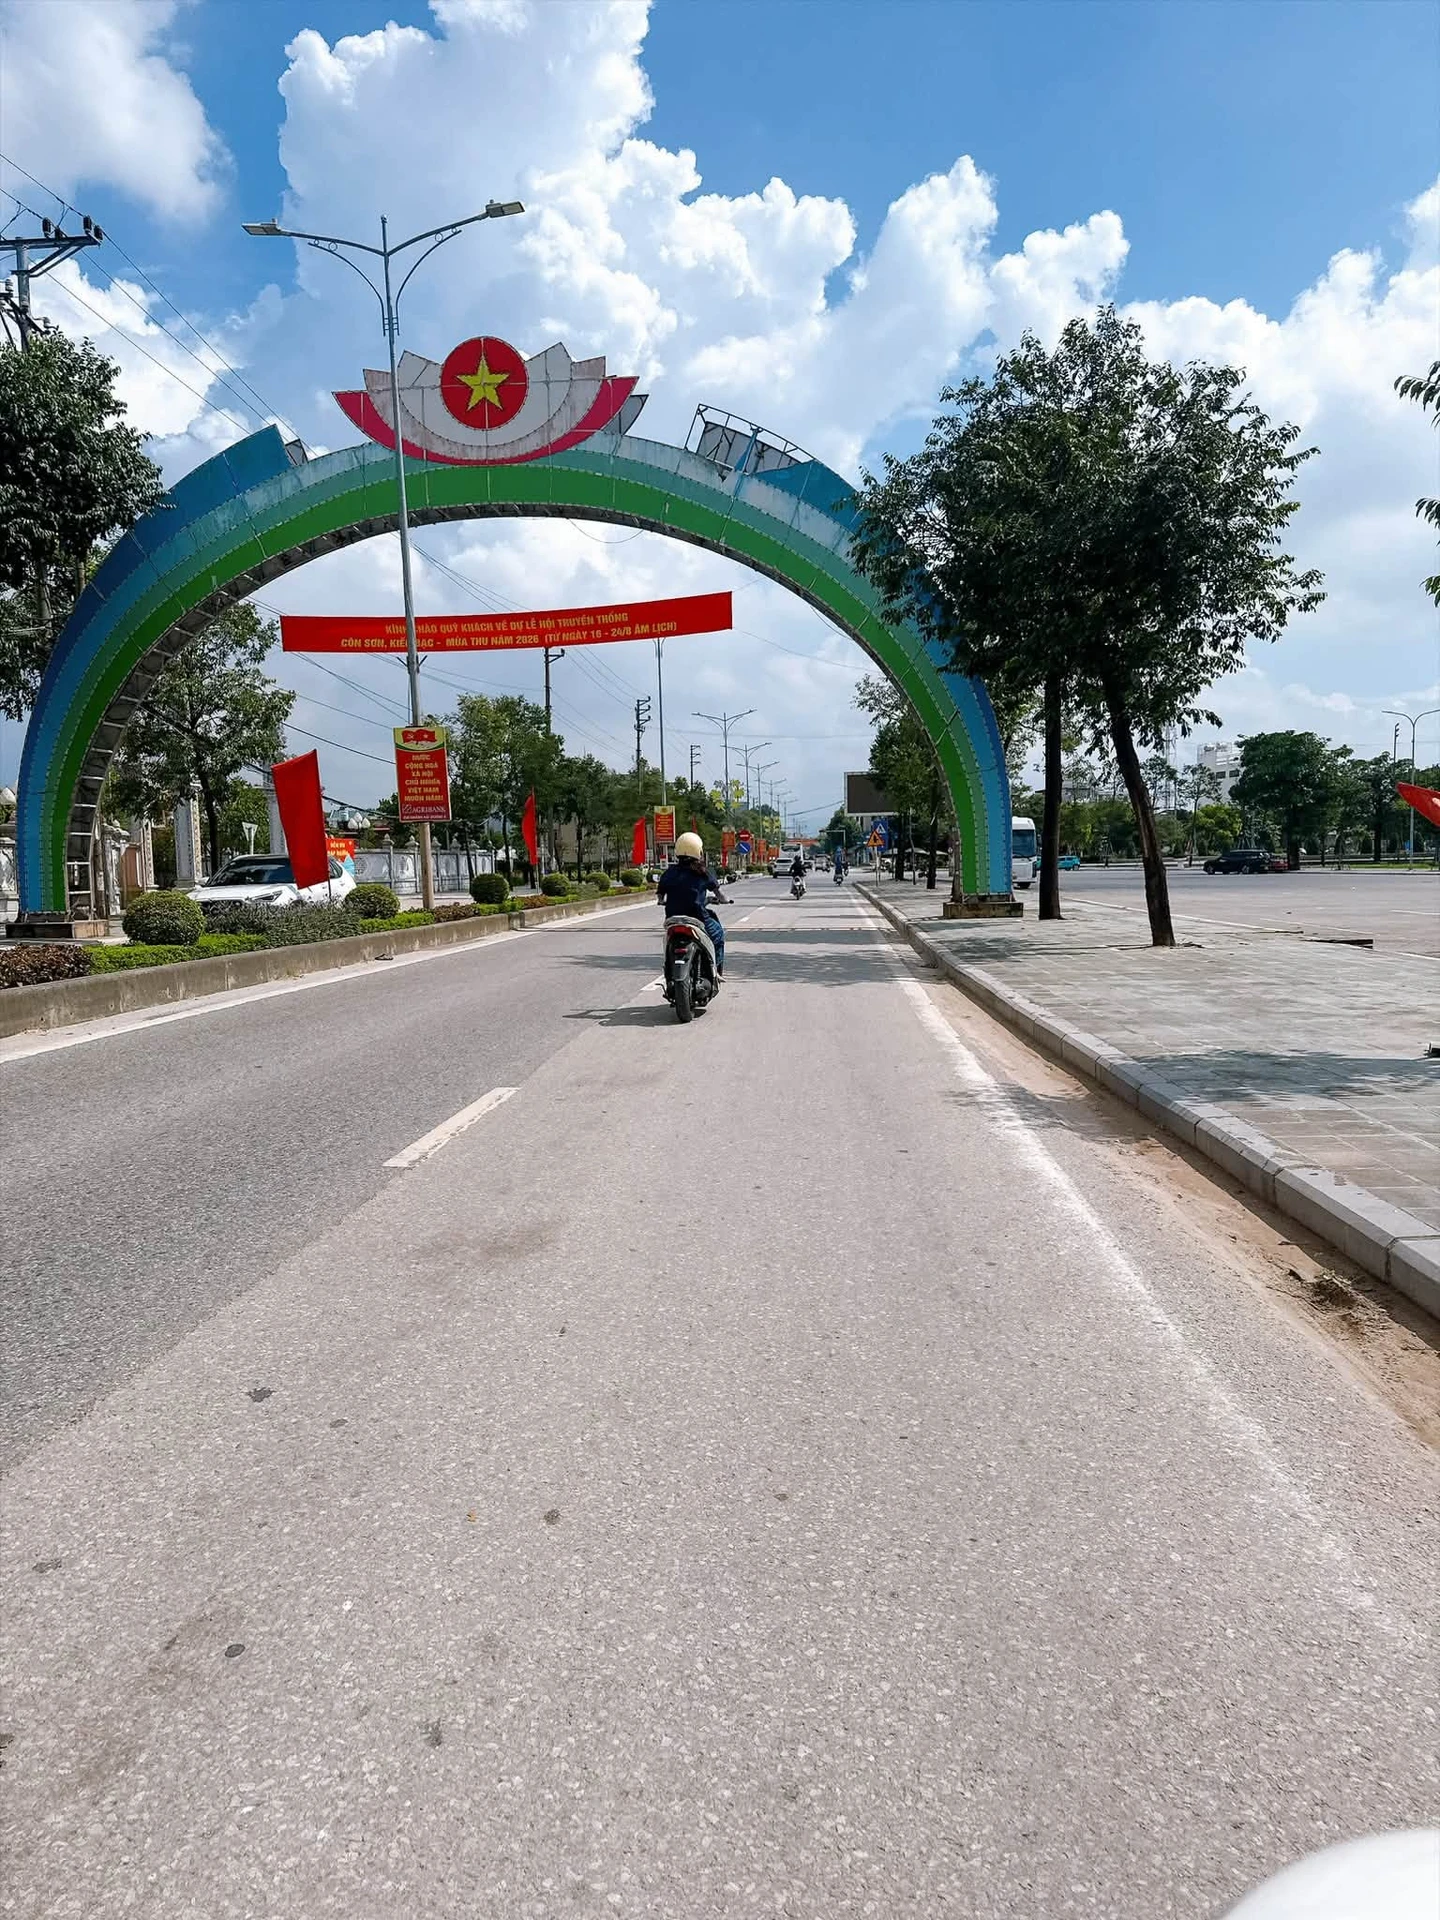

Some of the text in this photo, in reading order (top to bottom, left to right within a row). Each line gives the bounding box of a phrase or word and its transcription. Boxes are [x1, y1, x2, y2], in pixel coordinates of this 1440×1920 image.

[416, 622, 437, 634] HÀO
[440, 622, 458, 633] QUÝ
[461, 621, 494, 632] KHÁCH
[495, 619, 508, 631] VỀ
[510, 619, 524, 632] DỰ
[526, 617, 537, 630] LỄ
[539, 617, 556, 630] HỘI
[558, 614, 595, 628] TRUYỀN
[596, 610, 629, 624] THỐNG
[341, 637, 362, 647] CÔN
[364, 638, 387, 649] SƠN,
[446, 636, 468, 647] MÙA
[470, 637, 488, 646] THU
[491, 635, 513, 646] NĂM
[516, 634, 539, 645] 2026
[544, 632, 560, 644] (TỪ
[562, 629, 588, 642] NGÀY
[590, 630, 602, 639] 16
[634, 622, 650, 634] ÂM
[652, 622, 677, 634] LỊCH)
[422, 770, 433, 778] HỘI
[407, 786, 422, 794] VIỆT
